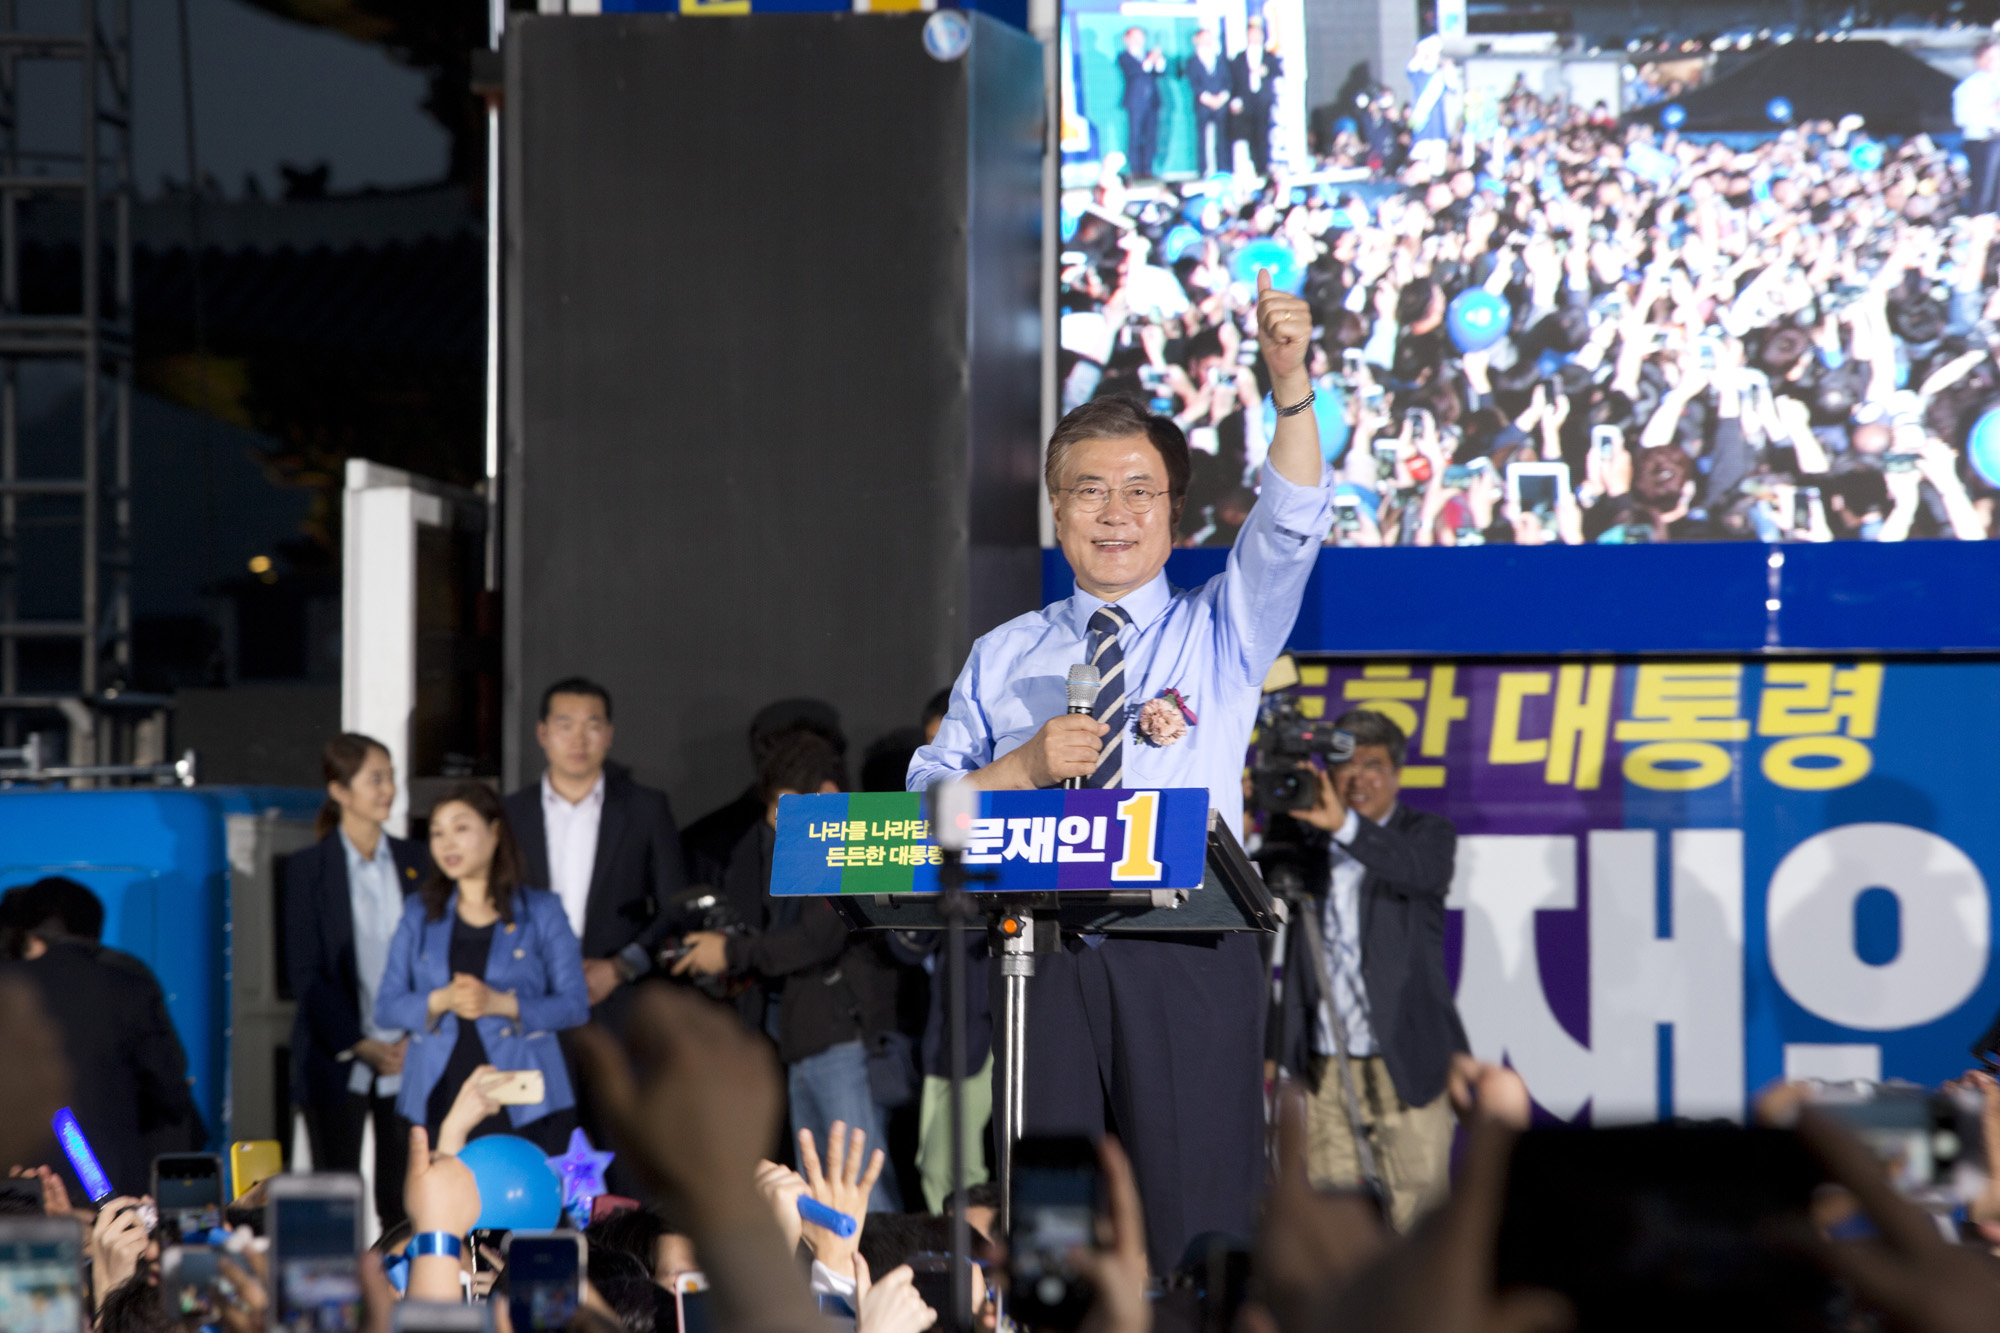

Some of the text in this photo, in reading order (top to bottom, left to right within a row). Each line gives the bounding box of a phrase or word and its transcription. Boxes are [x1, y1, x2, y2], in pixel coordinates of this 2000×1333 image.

[1488, 663, 1884, 791] 대통령
[808, 819, 934, 842] 나라를 나라답
[825, 845, 886, 867] 든든한
[960, 790, 1163, 882] 문재인 1
